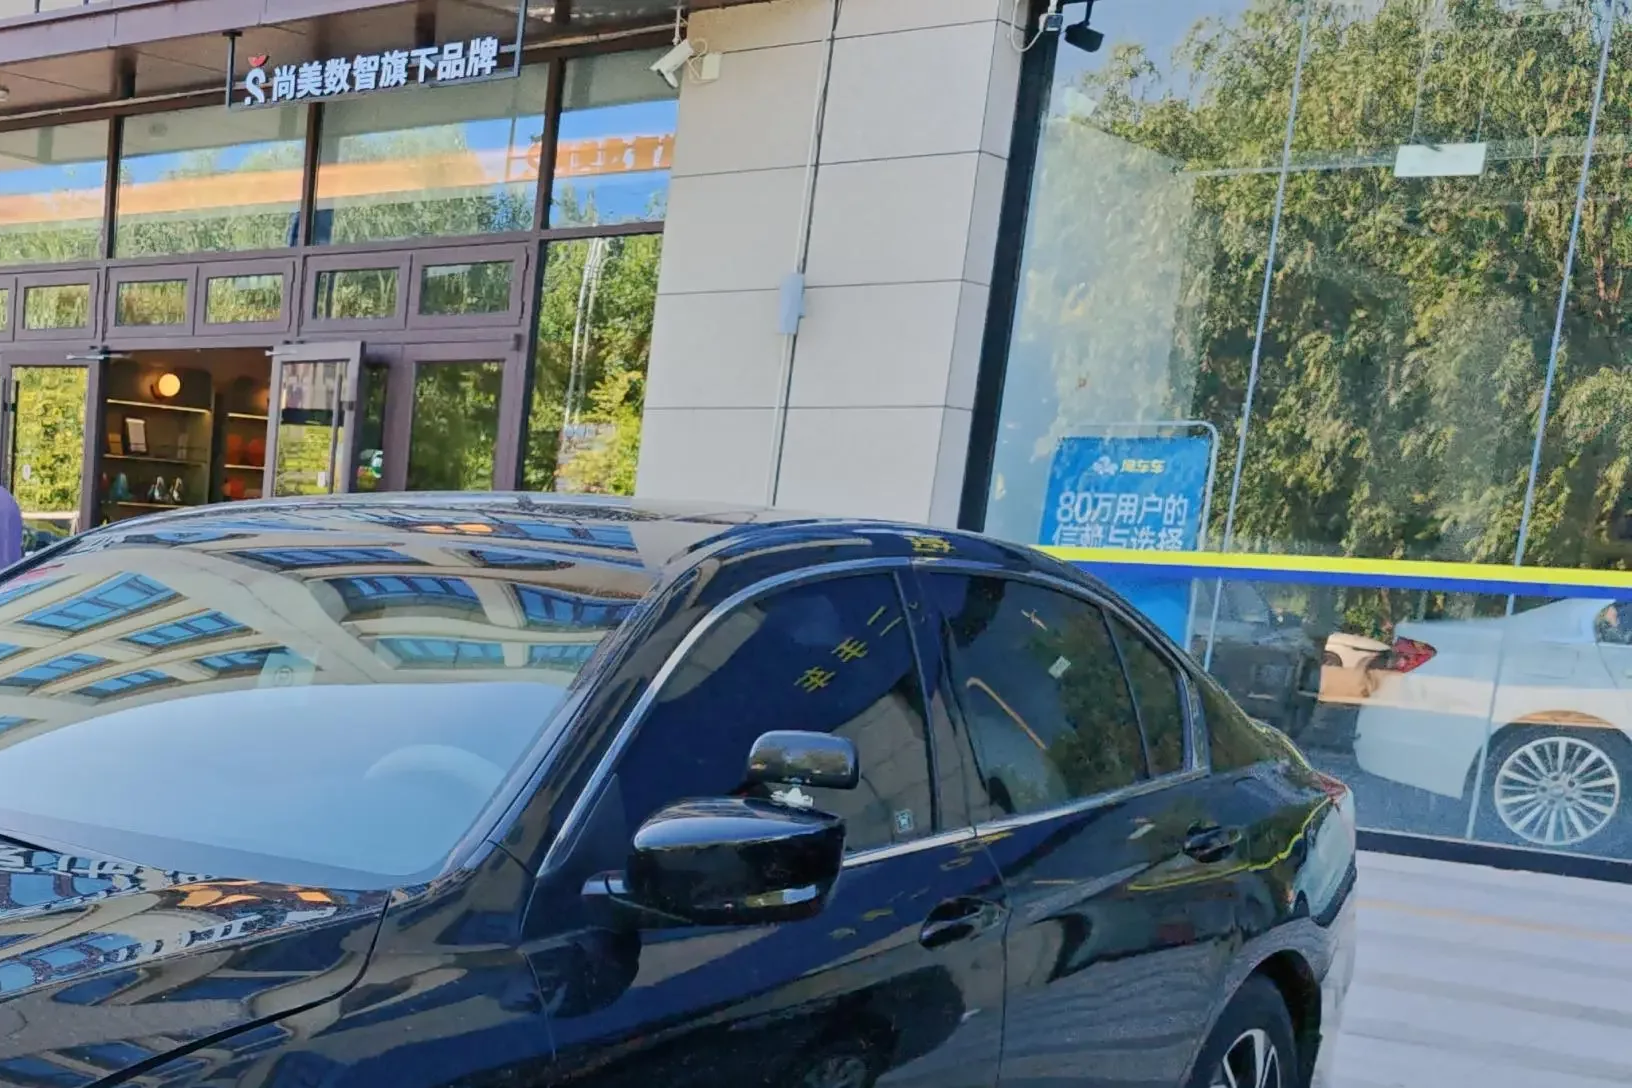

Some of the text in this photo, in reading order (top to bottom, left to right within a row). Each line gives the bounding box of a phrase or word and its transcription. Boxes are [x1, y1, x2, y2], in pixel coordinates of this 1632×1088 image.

[272, 36, 498, 101] 尚美数智旗下品牌
[1056, 491, 1188, 526] 80万用户的
